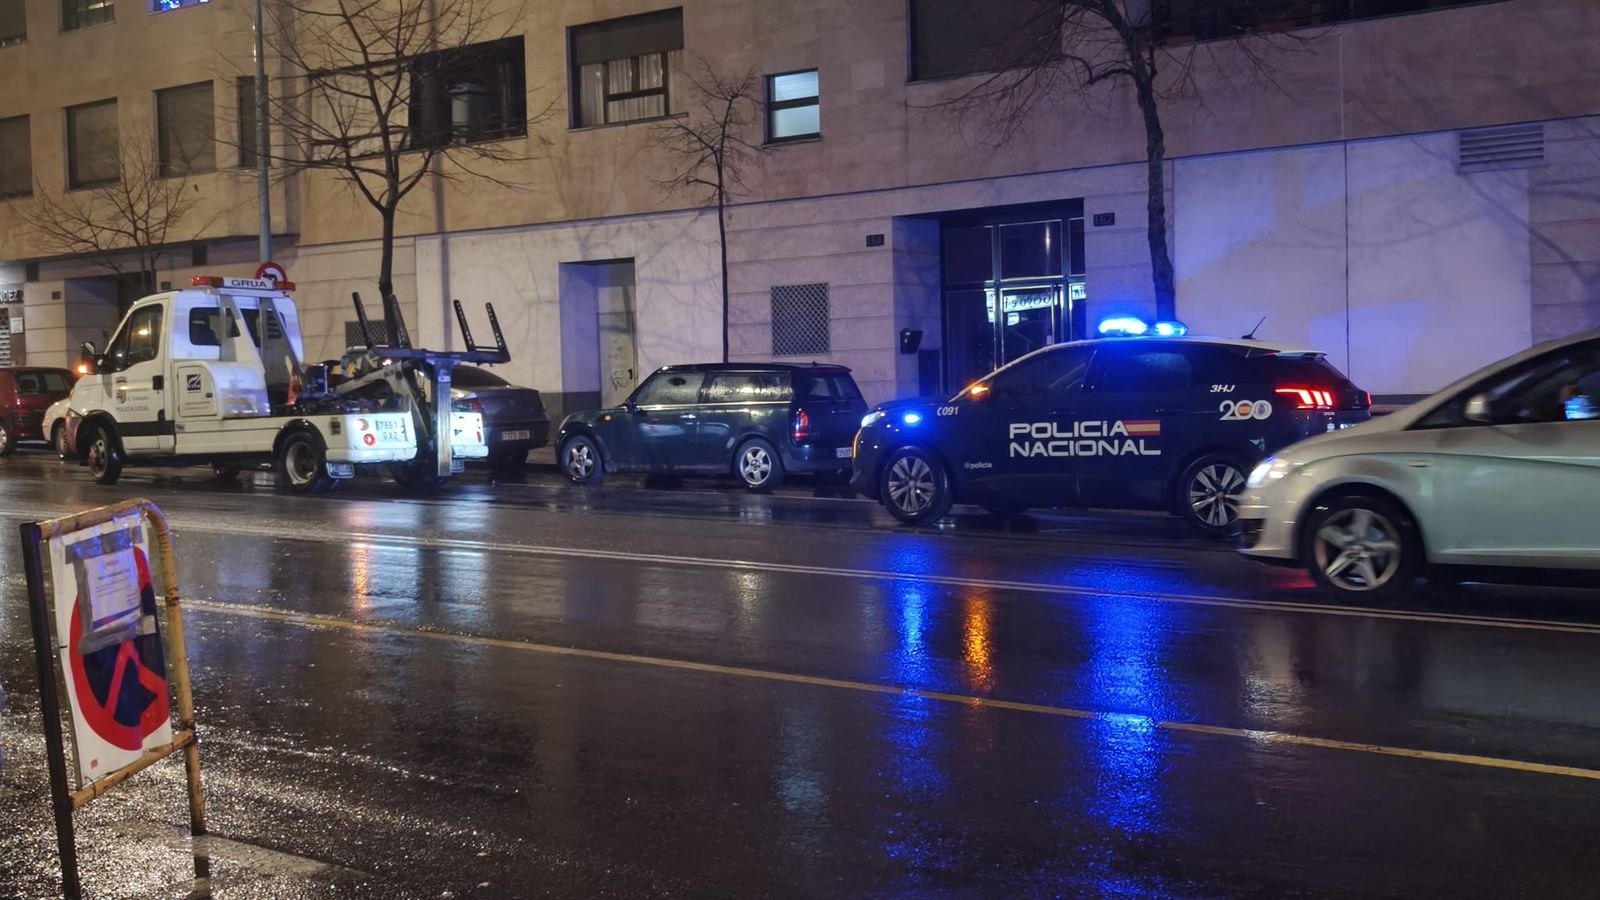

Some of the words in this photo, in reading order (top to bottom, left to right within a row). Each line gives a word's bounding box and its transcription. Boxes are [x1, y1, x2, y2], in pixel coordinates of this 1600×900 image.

[231, 279, 268, 288] GRUA
[1210, 384, 1235, 393] 3HJ
[1219, 400, 1273, 421] 200
[1009, 439, 1161, 457] NACIONAL
